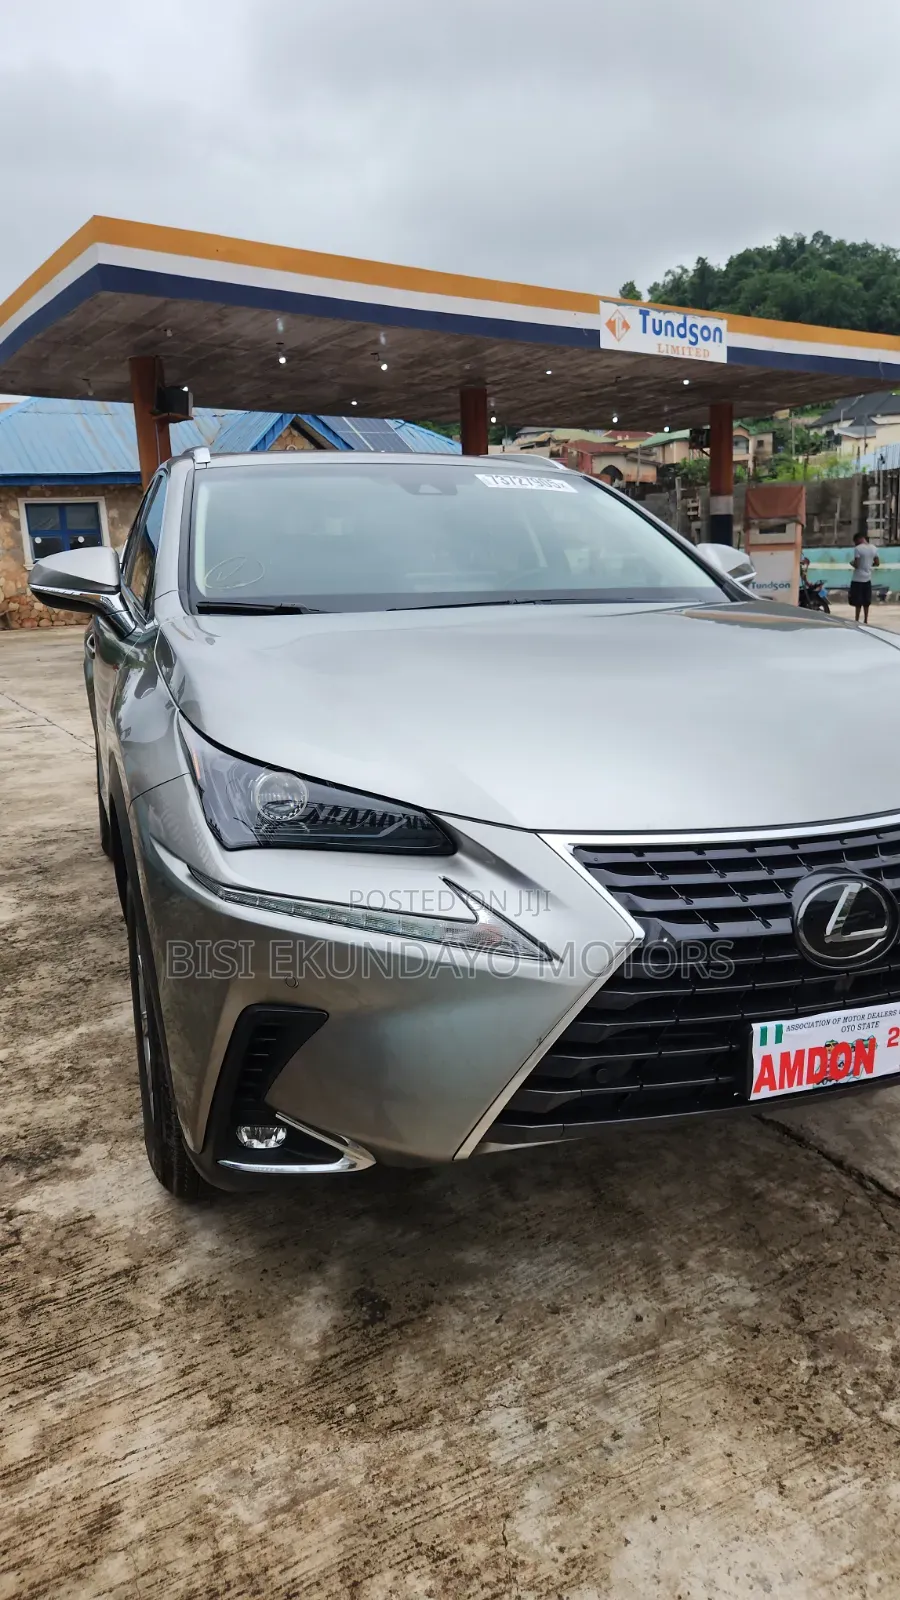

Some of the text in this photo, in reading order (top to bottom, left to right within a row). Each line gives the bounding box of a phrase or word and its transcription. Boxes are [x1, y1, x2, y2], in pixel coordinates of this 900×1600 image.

[638, 309, 723, 346] Tundson
[657, 343, 710, 358] LIMITED
[751, 581, 791, 590] Tundson
[785, 1018, 831, 1032] ASSOCIATION
[832, 1017, 841, 1025] OF
[842, 1013, 866, 1024] MOTOR
[867, 1009, 897, 1020] DEALERS
[840, 1020, 880, 1033] OYO STATE
[753, 1037, 877, 1094] AMDON
